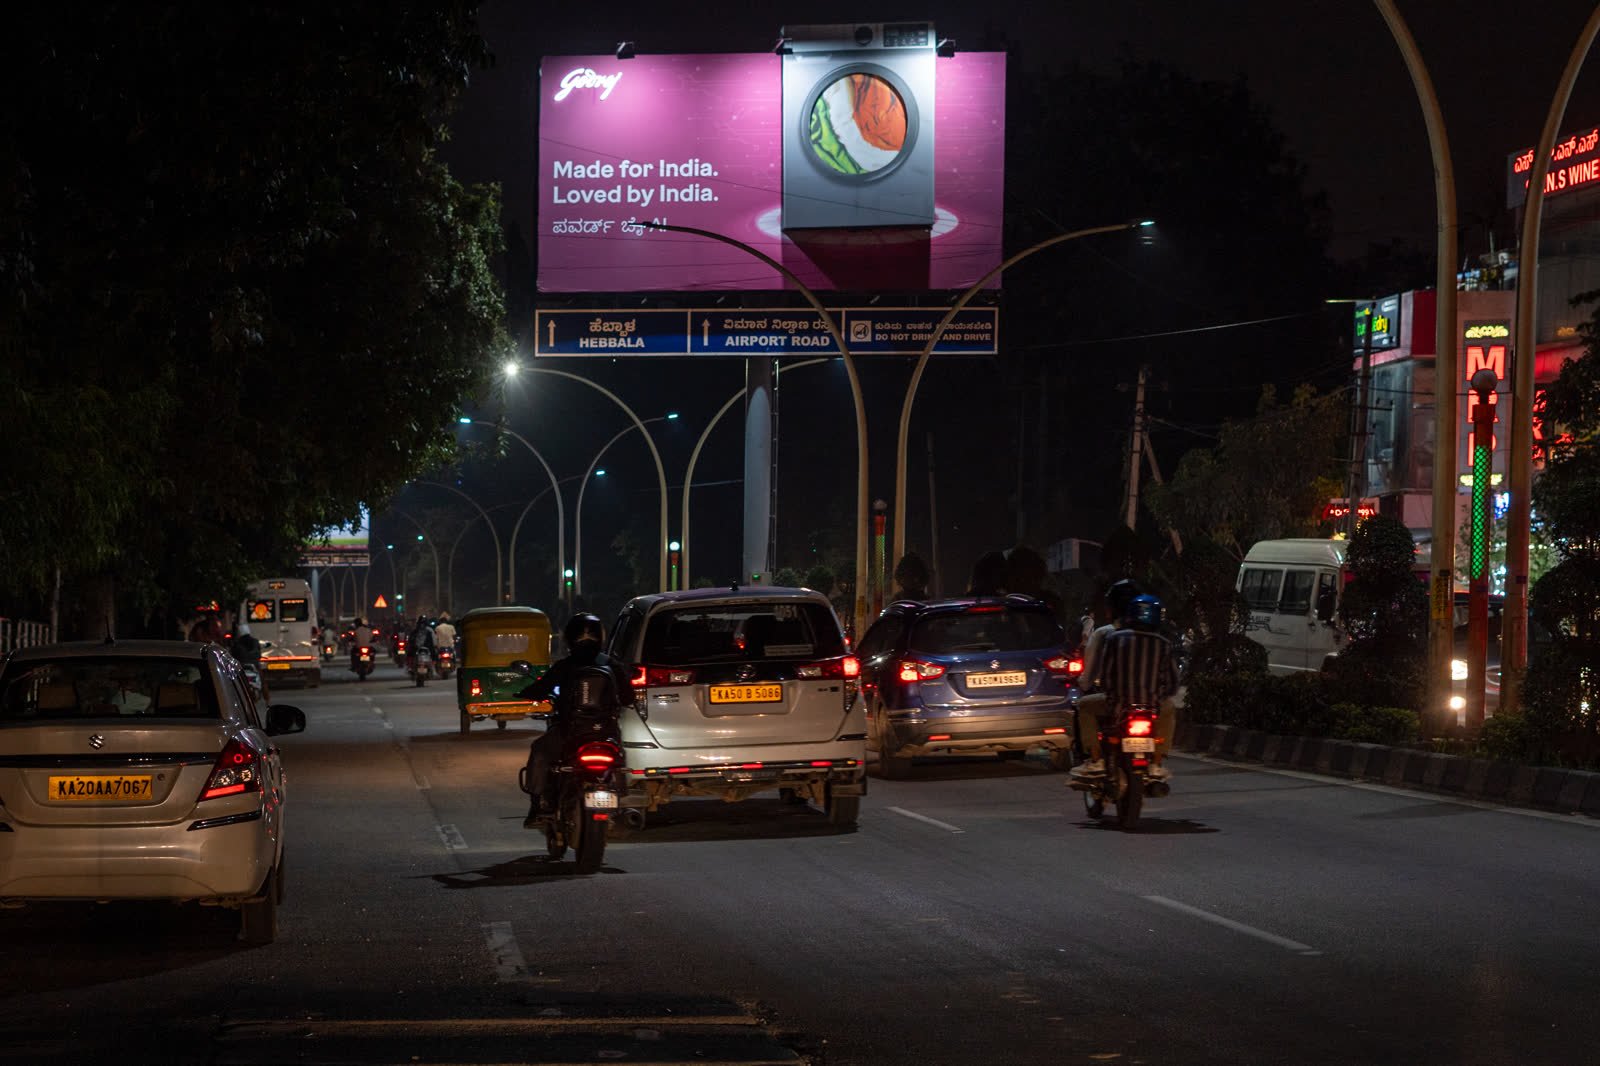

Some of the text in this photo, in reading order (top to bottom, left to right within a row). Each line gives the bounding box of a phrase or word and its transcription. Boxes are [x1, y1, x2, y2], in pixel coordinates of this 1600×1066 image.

[554, 68, 623, 101] Godrej
[553, 158, 719, 179] Made for India.
[1568, 158, 1600, 186] WINE
[553, 183, 719, 207] Loved by India.
[589, 317, 636, 337] ಹೆಬ್ಬಾಳ
[723, 318, 768, 330] ವಿಮಾನ
[579, 337, 645, 348] HEBBALA
[725, 335, 830, 347] AIRPORT ROAD
[875, 333, 889, 341] DO
[890, 333, 910, 341] NOT
[912, 333, 940, 341] DRIN
[943, 333, 962, 341] AND
[718, 687, 780, 700] KA50 B 5086
[58, 780, 150, 796] KA20AA7067
